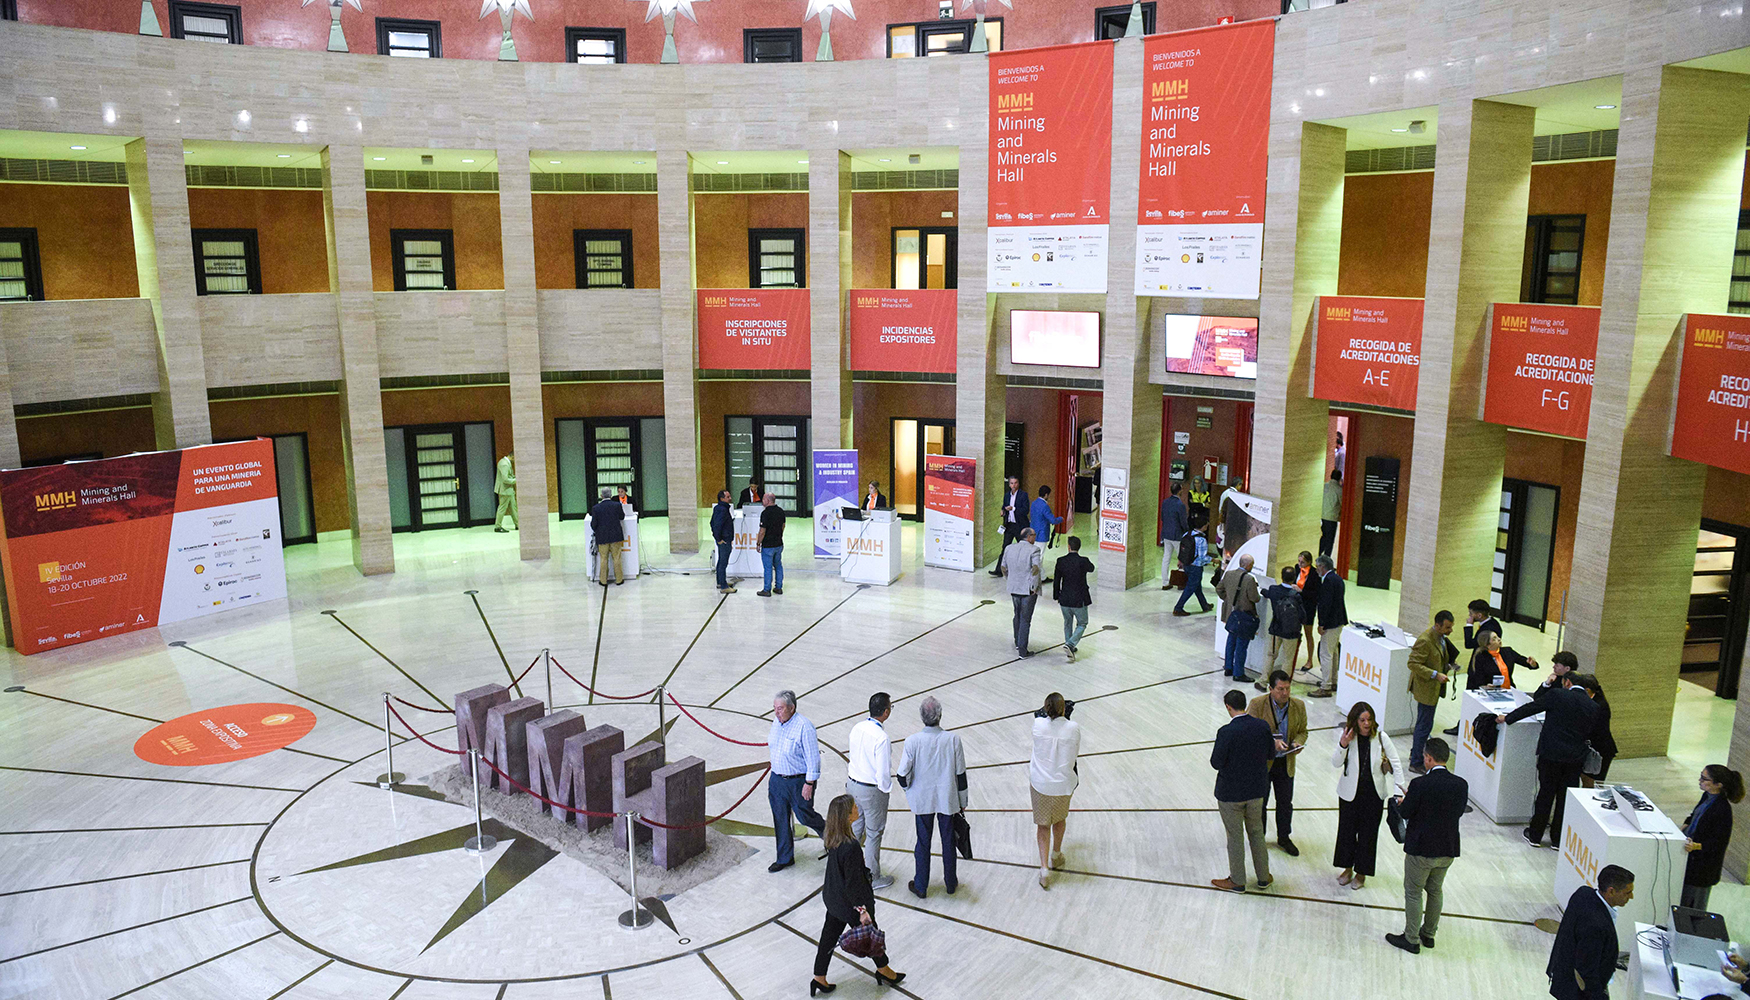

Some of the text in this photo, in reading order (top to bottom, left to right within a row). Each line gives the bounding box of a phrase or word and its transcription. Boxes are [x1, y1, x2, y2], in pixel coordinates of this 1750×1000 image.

[1153, 49, 1195, 62] BIENVENIDOS
[998, 65, 1039, 76] BIENVENIDOS
[1152, 59, 1194, 71] WELCOME TO
[998, 74, 1038, 84] WELCOME TO
[1152, 79, 1188, 97] MMH
[998, 92, 1033, 108] MMH
[1151, 104, 1200, 122] Mining
[998, 116, 1045, 132] Mining
[1150, 124, 1176, 140] and
[998, 133, 1022, 148] and
[1150, 140, 1211, 158] Minerals
[998, 149, 1057, 165] Minerals
[998, 168, 1024, 182] Hall
[1149, 161, 1176, 176] Hall
[1327, 307, 1351, 317] MMH
[1501, 316, 1528, 328] MMH
[1531, 317, 1551, 327] Mining
[882, 326, 933, 334] INCIDENCIAS
[1530, 326, 1555, 334] Minerals
[1694, 328, 1724, 343] MMH
[880, 336, 936, 344] EXPOSITORES
[1350, 339, 1412, 352] RECOGIDA DE
[1726, 341, 1750, 351] Minera
[1340, 350, 1419, 365] ACREDITACIONES
[1526, 353, 1594, 371] RECOGIDA DE
[1363, 368, 1390, 386] A-E
[1515, 366, 1594, 386] ACREDITACIONE
[1542, 389, 1569, 410] F-G
[205, 465, 234, 474] EVENTO
[235, 461, 262, 471] GLOBAL
[231, 470, 261, 479] MINERIA
[80, 484, 128, 497] Mining and
[206, 480, 252, 493] VANGUARDIA
[35, 491, 76, 507] MMH
[81, 491, 136, 505] Minerals Hall
[735, 533, 758, 545] MH
[847, 537, 883, 552] MMH
[55, 561, 86, 573] EDICIÓN
[46, 574, 72, 584] Sevilla
[48, 573, 128, 594] 18-20 OCTUBRE 2022
[1346, 652, 1382, 686] MMH
[224, 723, 248, 737] ACCESO
[166, 735, 198, 754] MMH
[455, 683, 706, 871] MMH
[1565, 825, 1598, 883] MMH
